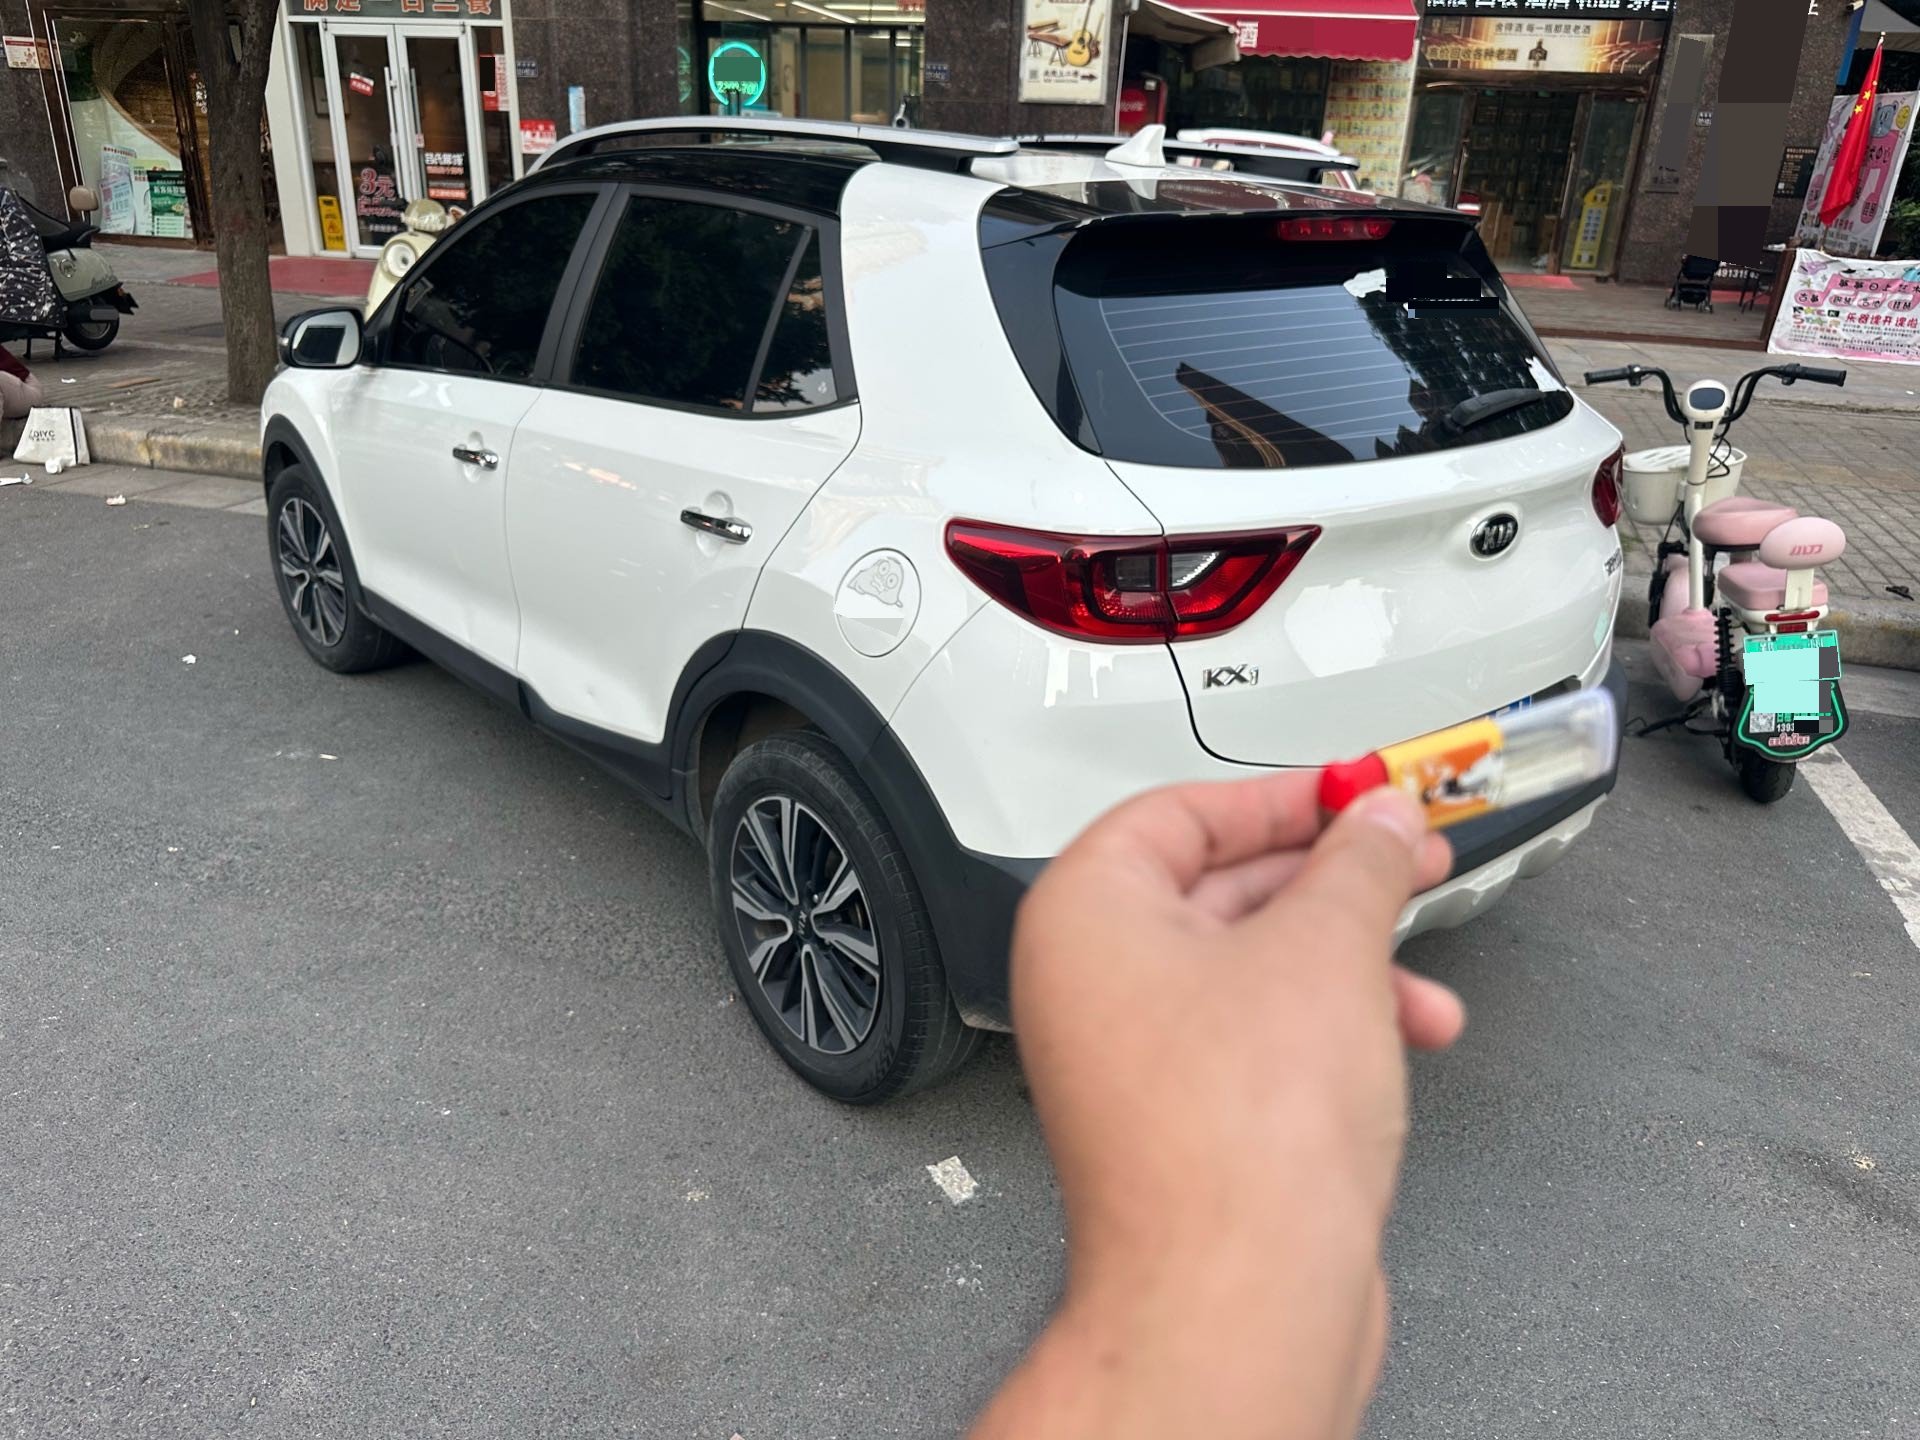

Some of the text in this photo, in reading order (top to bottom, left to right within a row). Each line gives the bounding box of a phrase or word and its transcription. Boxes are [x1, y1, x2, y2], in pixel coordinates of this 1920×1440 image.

[303, 0, 492, 14] 满足日三餐
